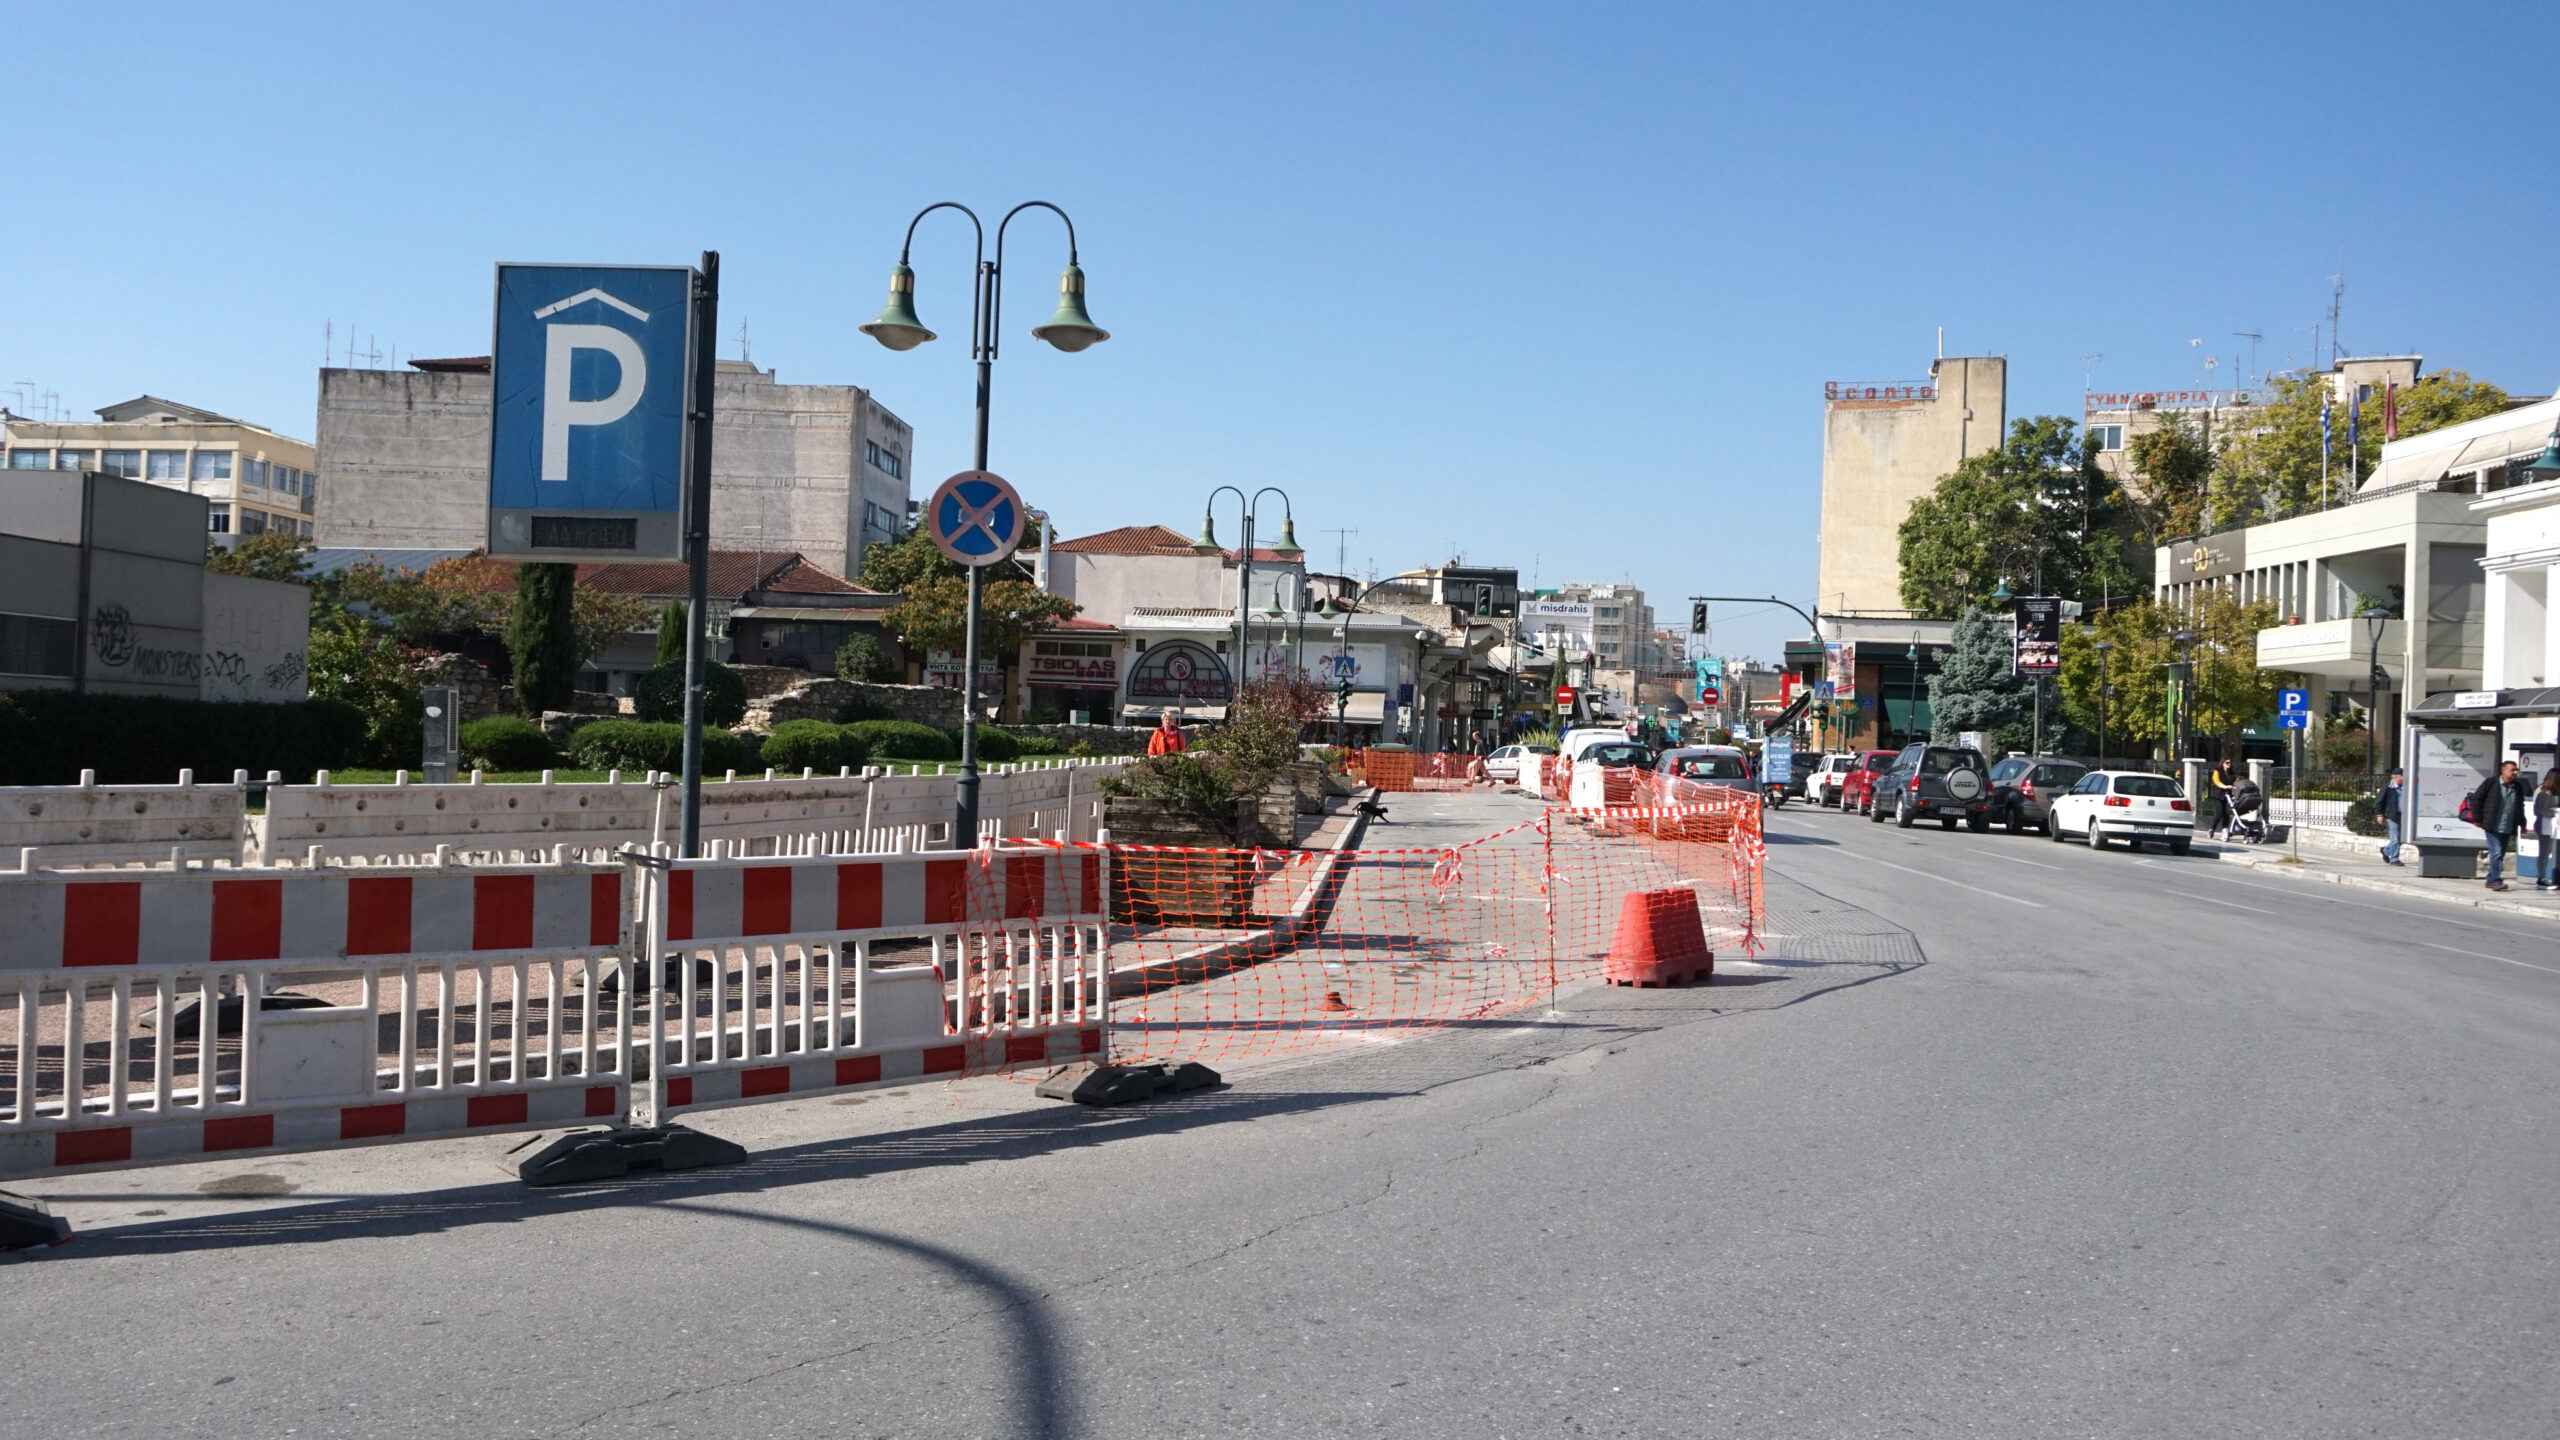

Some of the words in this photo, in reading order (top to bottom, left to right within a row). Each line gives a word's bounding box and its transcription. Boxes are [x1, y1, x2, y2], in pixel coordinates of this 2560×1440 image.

[541, 323, 647, 481] P
[1540, 603, 1588, 614] misdrahis
[1030, 658, 1116, 671] TSIOLAS
[2286, 693, 2301, 710] P
